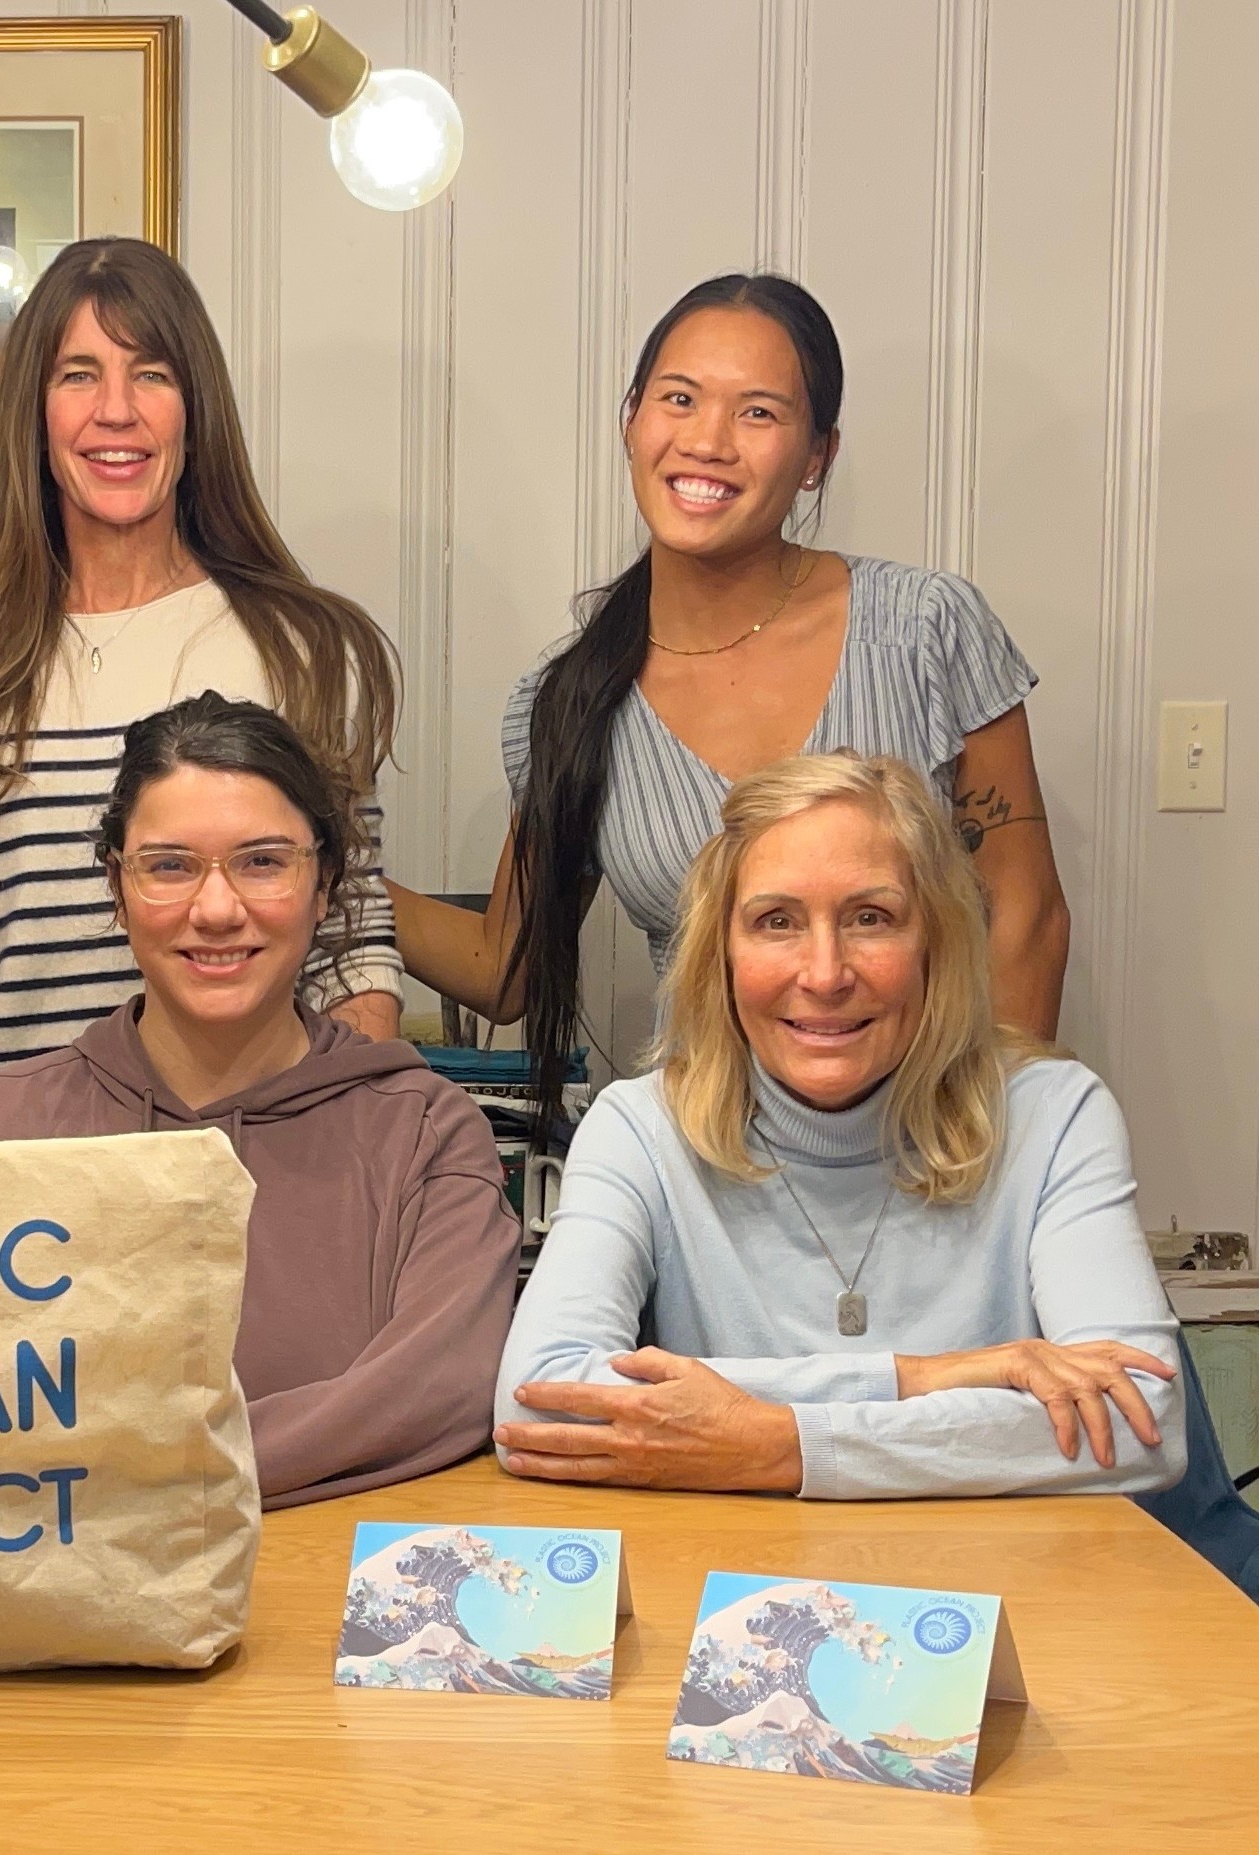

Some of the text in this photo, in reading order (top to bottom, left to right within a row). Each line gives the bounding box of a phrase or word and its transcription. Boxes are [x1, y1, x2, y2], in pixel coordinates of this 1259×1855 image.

[469, 1086, 533, 1096] ROJEC
[535, 1533, 610, 1564] PLASTIC OCEAN PROJECT
[901, 1601, 927, 1628] PLASTIC
[928, 1596, 964, 1606] OCEAN
